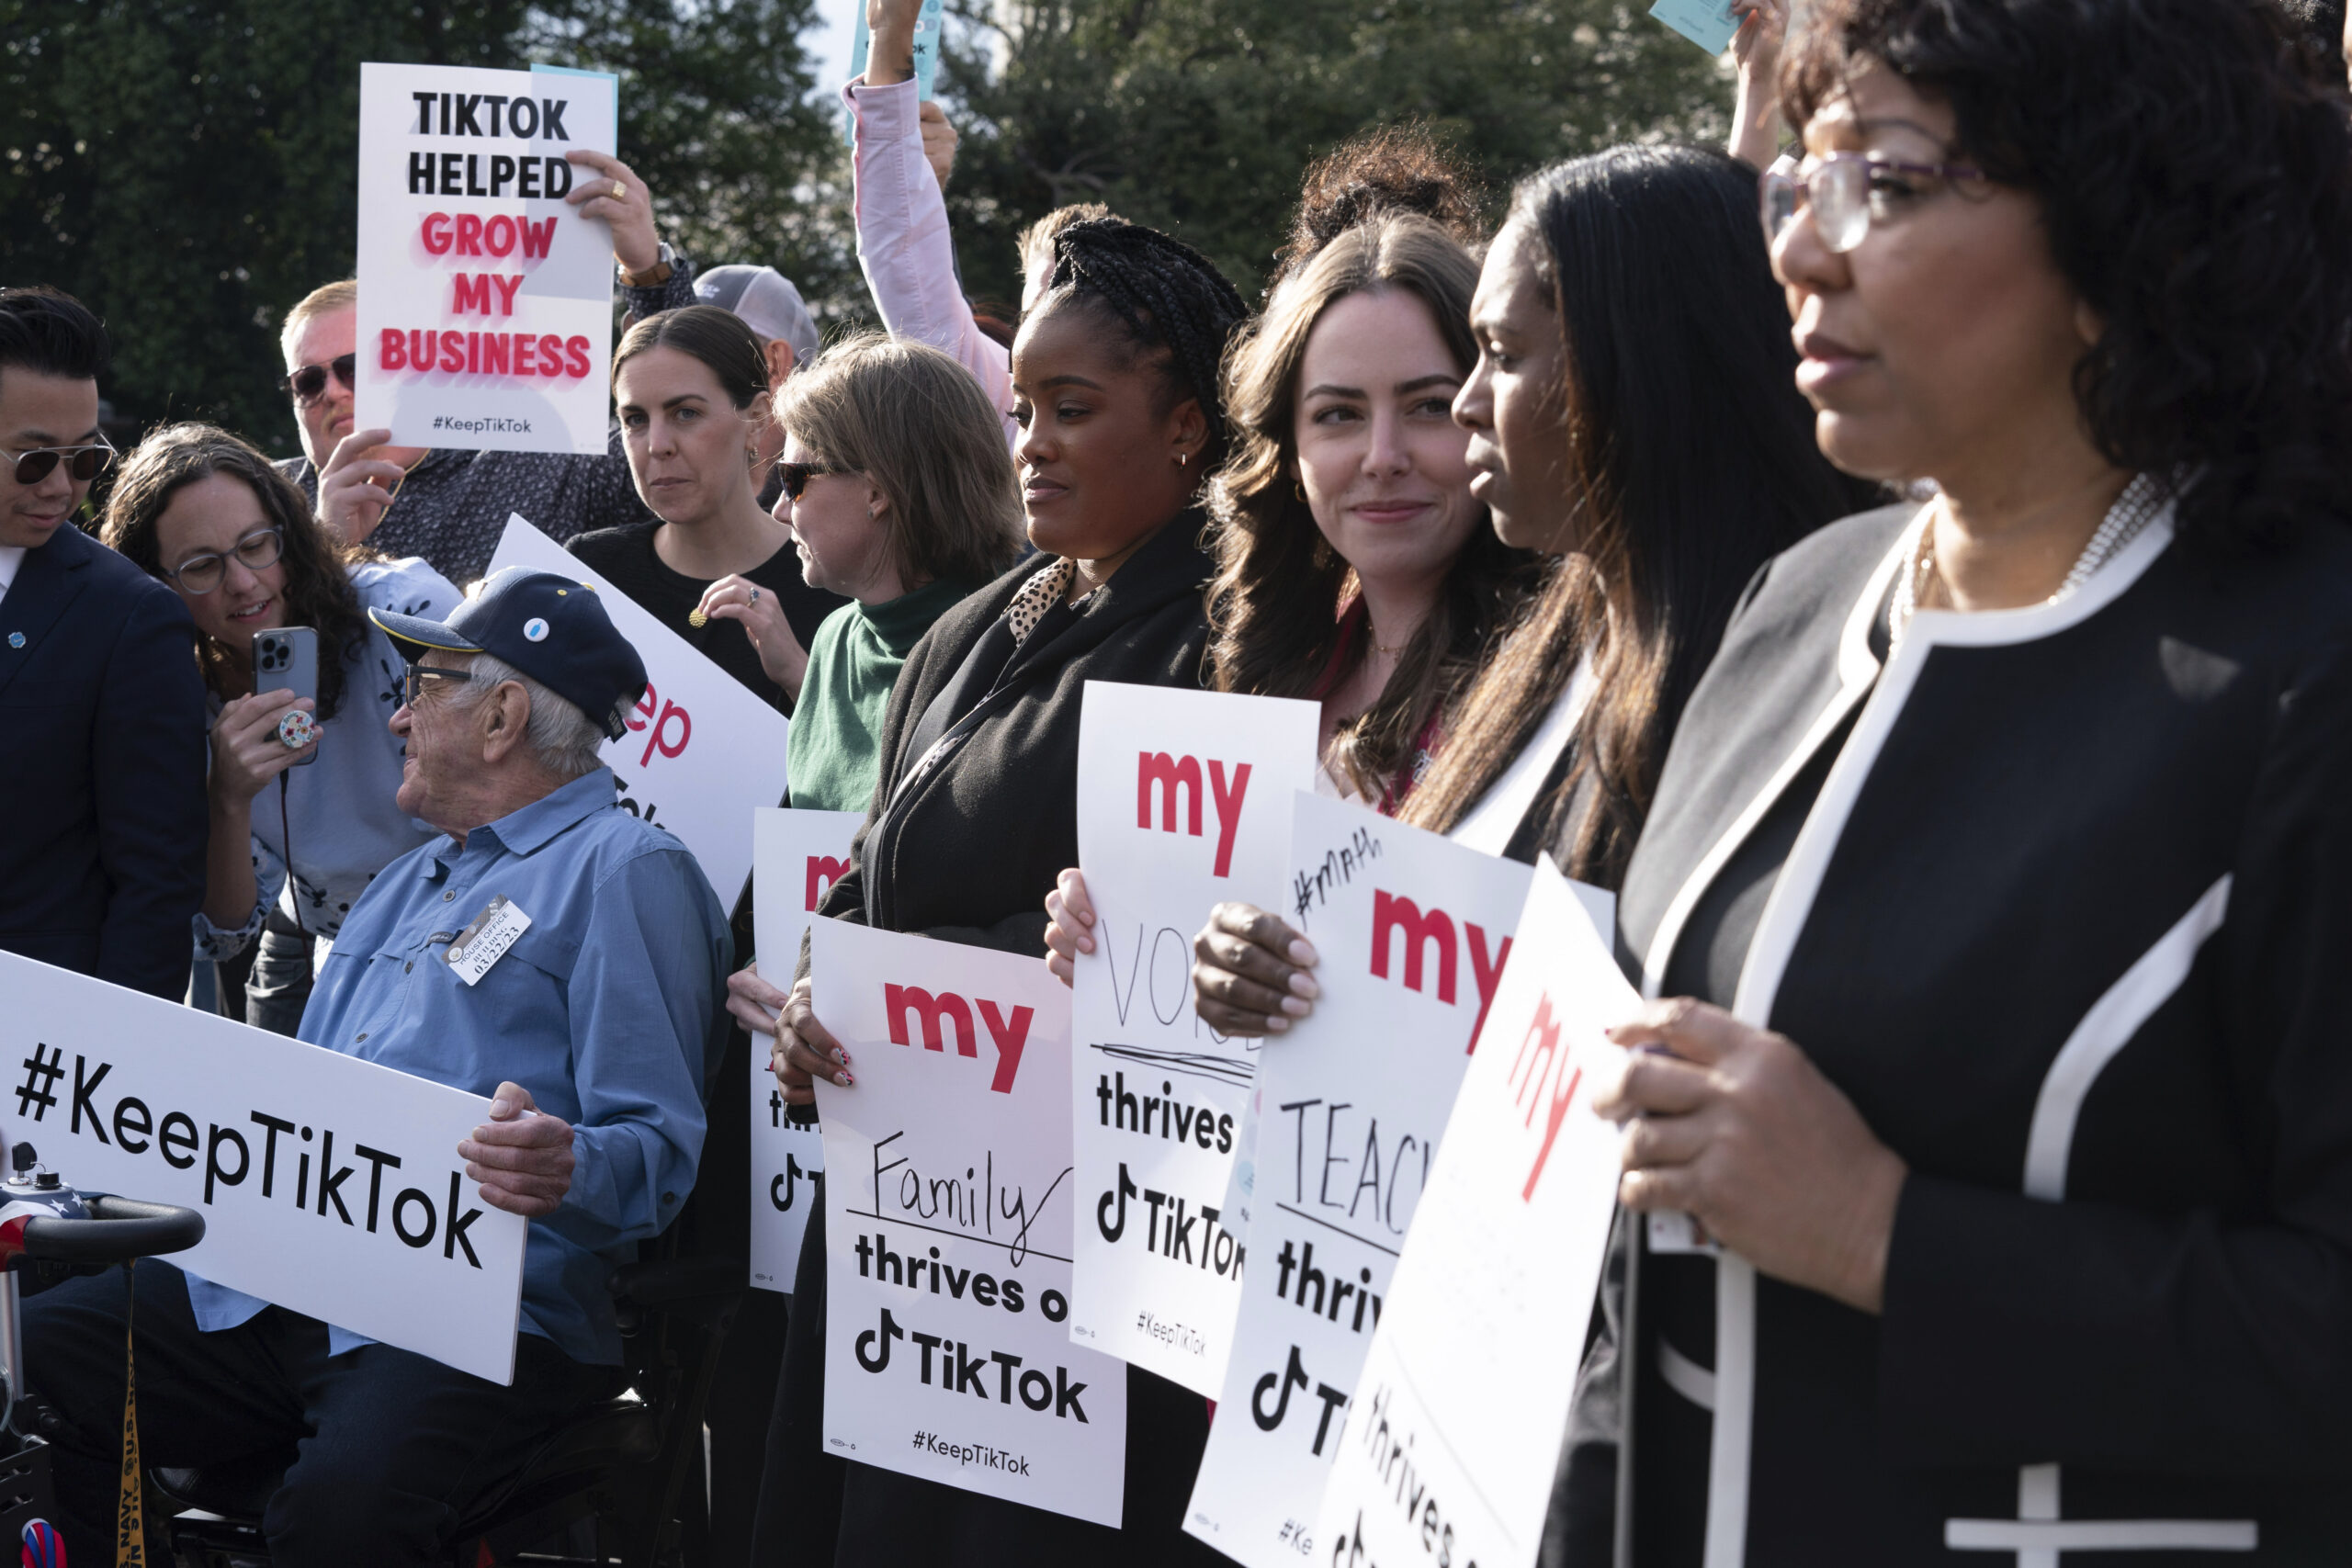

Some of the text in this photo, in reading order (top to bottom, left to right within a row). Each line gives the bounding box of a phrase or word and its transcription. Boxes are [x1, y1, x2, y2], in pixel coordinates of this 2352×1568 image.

[413, 92, 571, 141] TIKTOK
[409, 152, 572, 199] HELPED
[422, 211, 558, 259] GROW
[452, 273, 525, 316] MY
[380, 328, 591, 378] BUSINESS
[433, 416, 532, 434] #KeepTikTok
[1137, 750, 1253, 878] my
[460, 939, 484, 965] HOUSE
[483, 911, 509, 939] OFFICE
[473, 927, 507, 963] BUILDING
[474, 926, 520, 975] 03/22/23
[1369, 887, 1514, 1057] my
[884, 982, 1035, 1094] my
[1096, 1071, 1234, 1154] thrives
[1508, 988, 1583, 1205] my
[15, 1042, 484, 1270] #KeepTikTok
[874, 1131, 1074, 1268] Family
[854, 1234, 1069, 1323] thrives o
[1137, 1310, 1207, 1359] #KeepTikTok
[911, 1331, 1090, 1424] TikTok
[912, 1430, 1030, 1477] #KeepTikTok
[1363, 1382, 1454, 1568] thrives
[120, 1488, 133, 1549] NAVY
